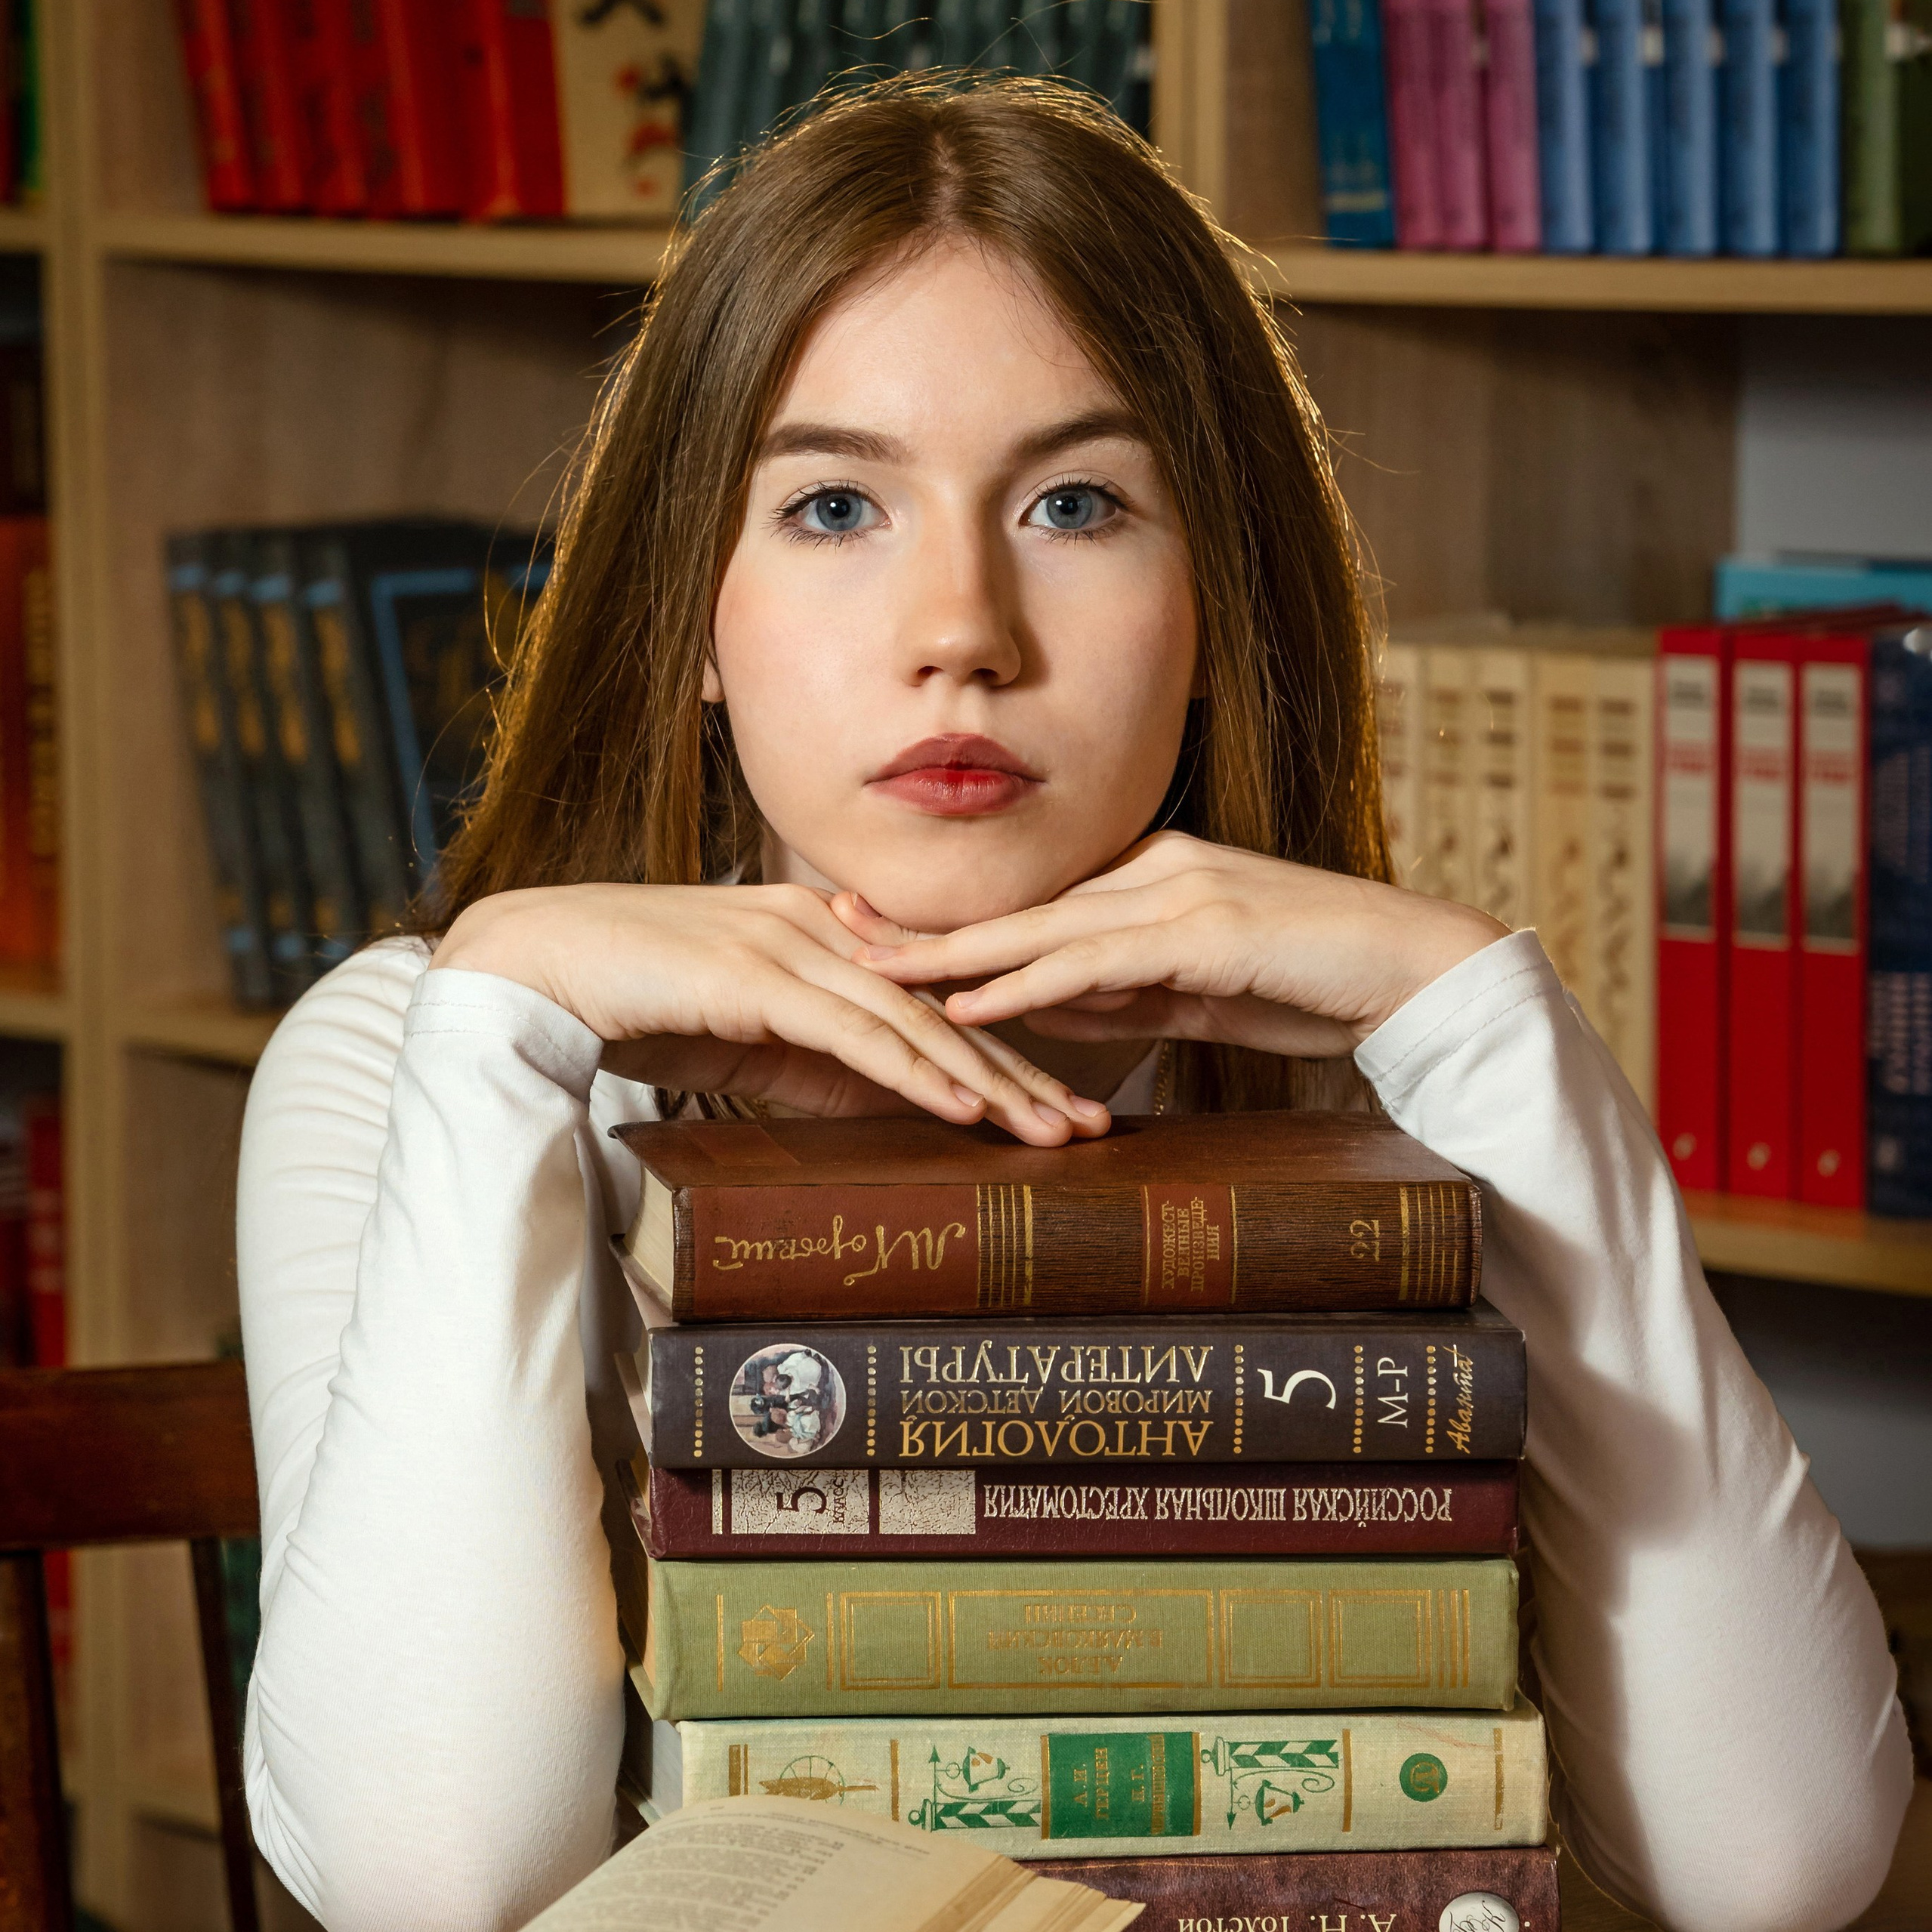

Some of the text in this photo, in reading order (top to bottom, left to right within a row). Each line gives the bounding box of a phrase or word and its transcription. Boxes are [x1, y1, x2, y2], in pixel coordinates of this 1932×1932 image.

[1350, 1219, 1380, 1261] 22
[900, 1340, 1214, 1384] ЛИТЕРАТУРЫ
[900, 1386, 1214, 1421] МИРОВОЙ ДЕТСКОЙ
[1257, 1368, 1336, 1409] 5
[899, 1421, 1214, 1457] АНТОЛОГИЯ
[776, 1486, 827, 1514] 5
[832, 1478, 845, 1523] КЛАСС
[983, 1485, 1452, 1527] РОССИЙСКАЯ ШКОЛЬНАЯ ХРЕСТОМАТИЯ
